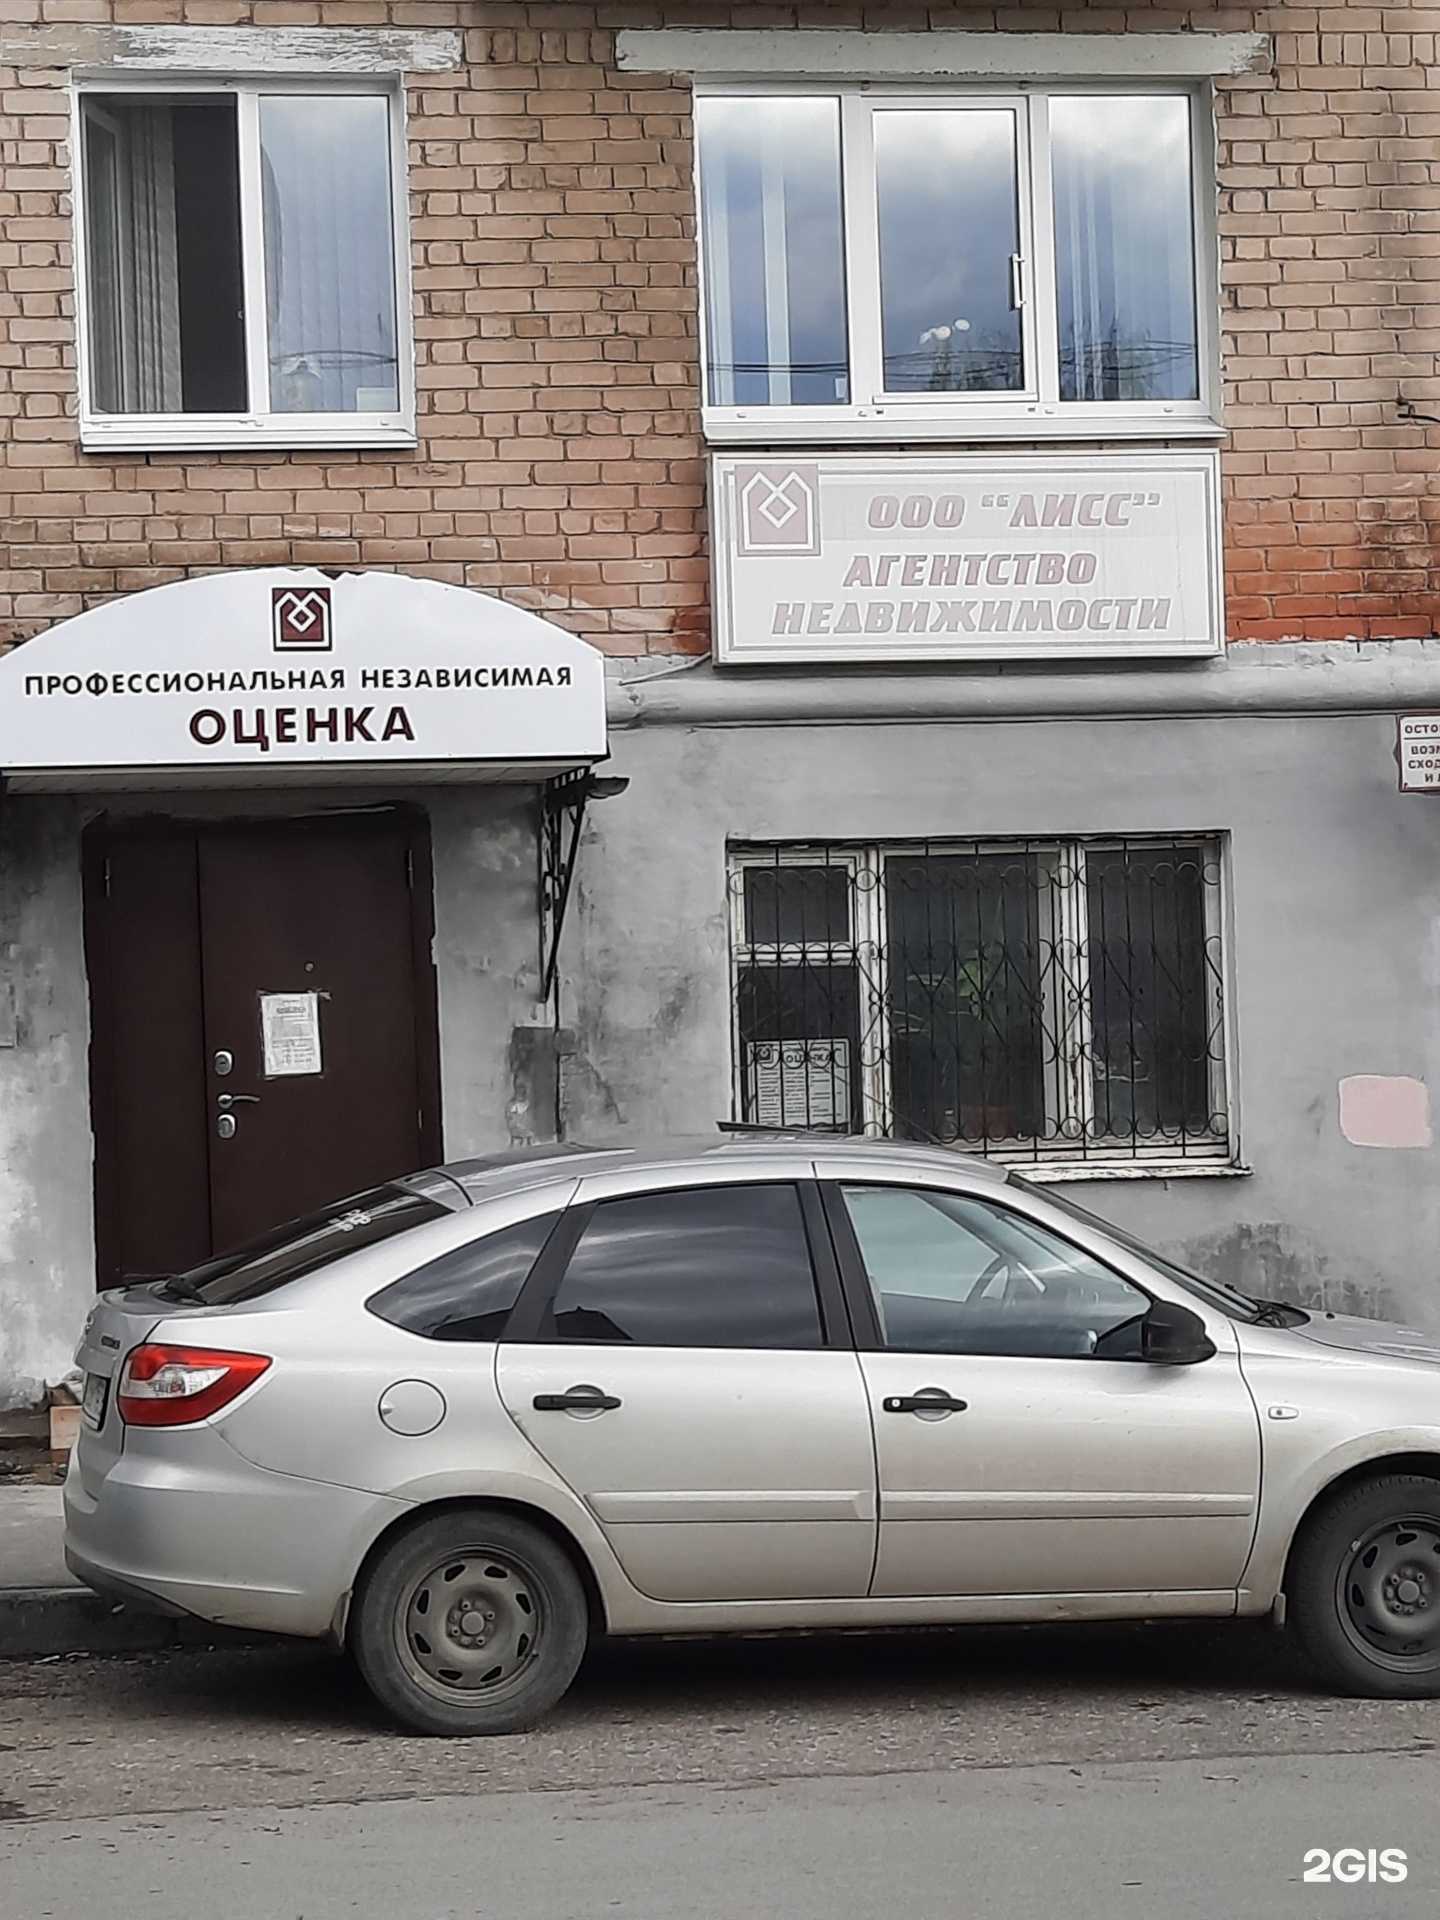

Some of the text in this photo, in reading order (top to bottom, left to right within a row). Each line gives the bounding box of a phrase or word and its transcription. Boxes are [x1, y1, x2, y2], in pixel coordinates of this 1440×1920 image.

[868, 494, 966, 529] ООО
[842, 552, 1098, 588] АГЕНТСТВО
[771, 597, 1172, 635] НЕДВИЖИМОСТИ
[25, 666, 571, 697] ПРОФЕССИОНАЛЬНАЯ НЕЗАВИСИМАЯ
[189, 706, 415, 752] ОЦЕНКА
[1424, 773, 1434, 783] И
